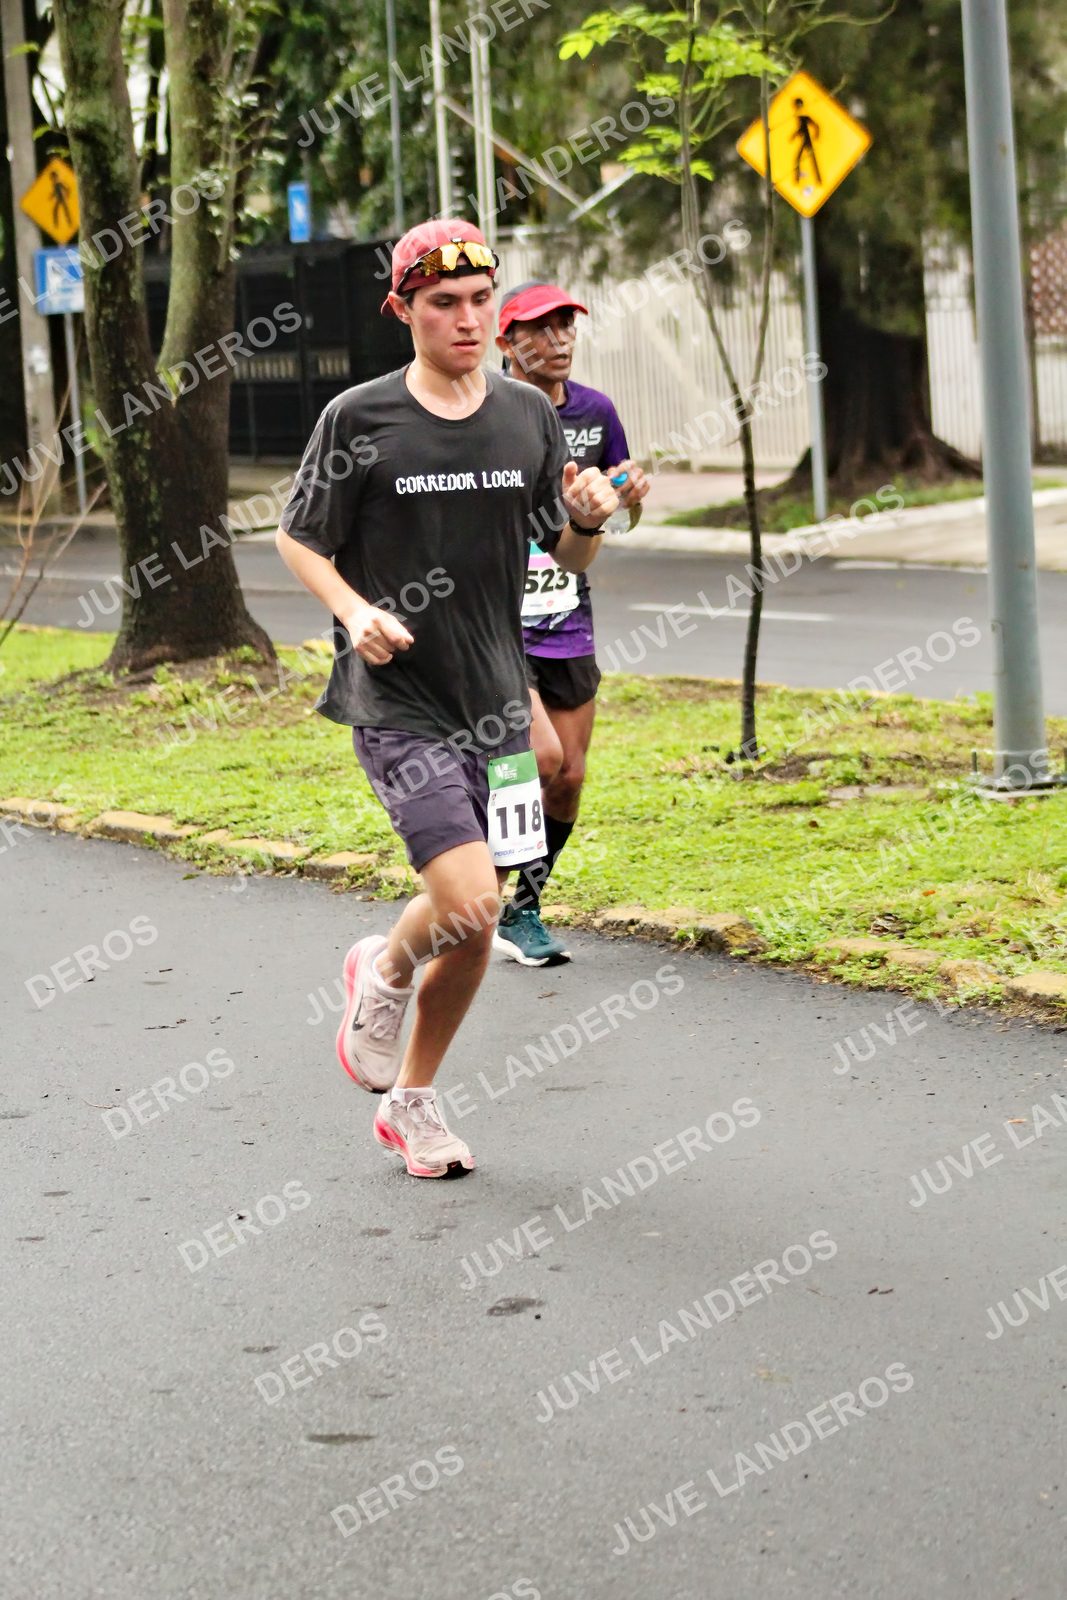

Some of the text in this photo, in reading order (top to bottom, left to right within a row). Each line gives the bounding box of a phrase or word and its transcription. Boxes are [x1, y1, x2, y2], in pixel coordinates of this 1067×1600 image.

[395, 469, 525, 495] CORREDOR LOCAL
[524, 567, 570, 595] 523
[495, 799, 542, 840] 118
